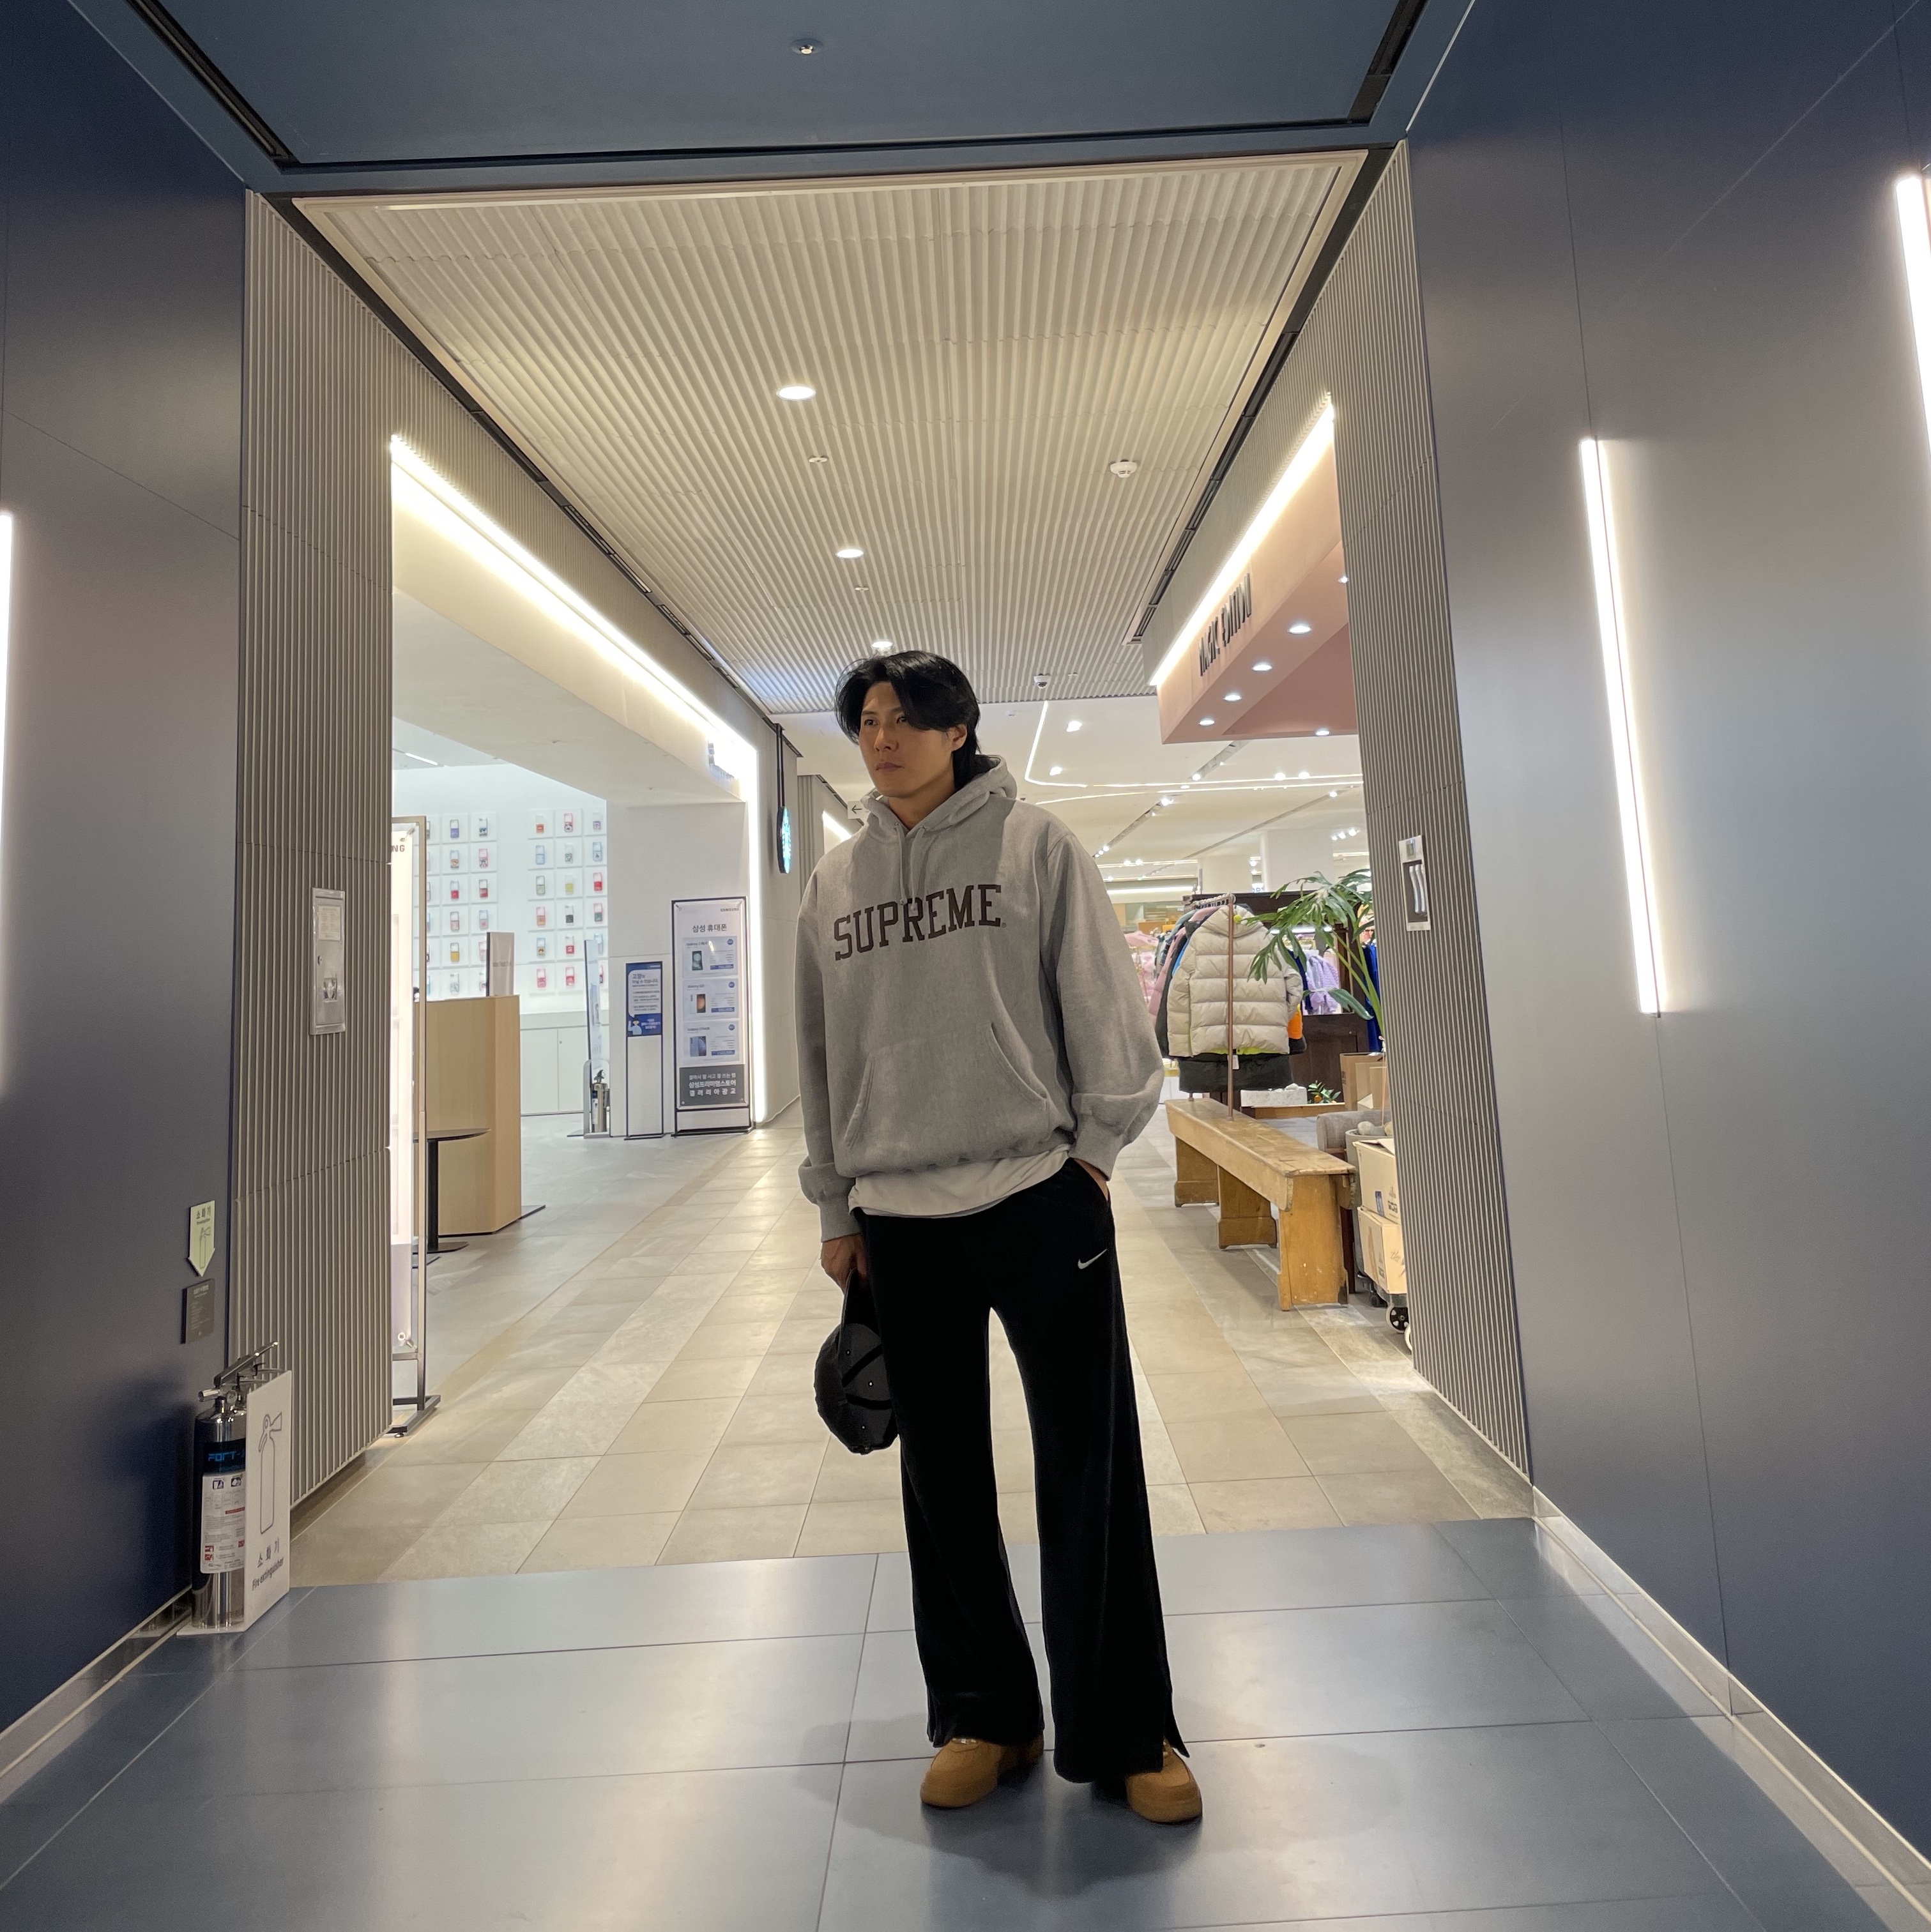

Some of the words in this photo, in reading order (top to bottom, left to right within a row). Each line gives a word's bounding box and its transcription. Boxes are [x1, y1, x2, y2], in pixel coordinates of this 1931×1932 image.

[692, 924, 706, 933] 삼성
[707, 924, 727, 932] 휴대폰
[834, 884, 1002, 961] SUPREME
[257, 1537, 280, 1568] 소화기
[260, 1556, 284, 1584] extinguisher
